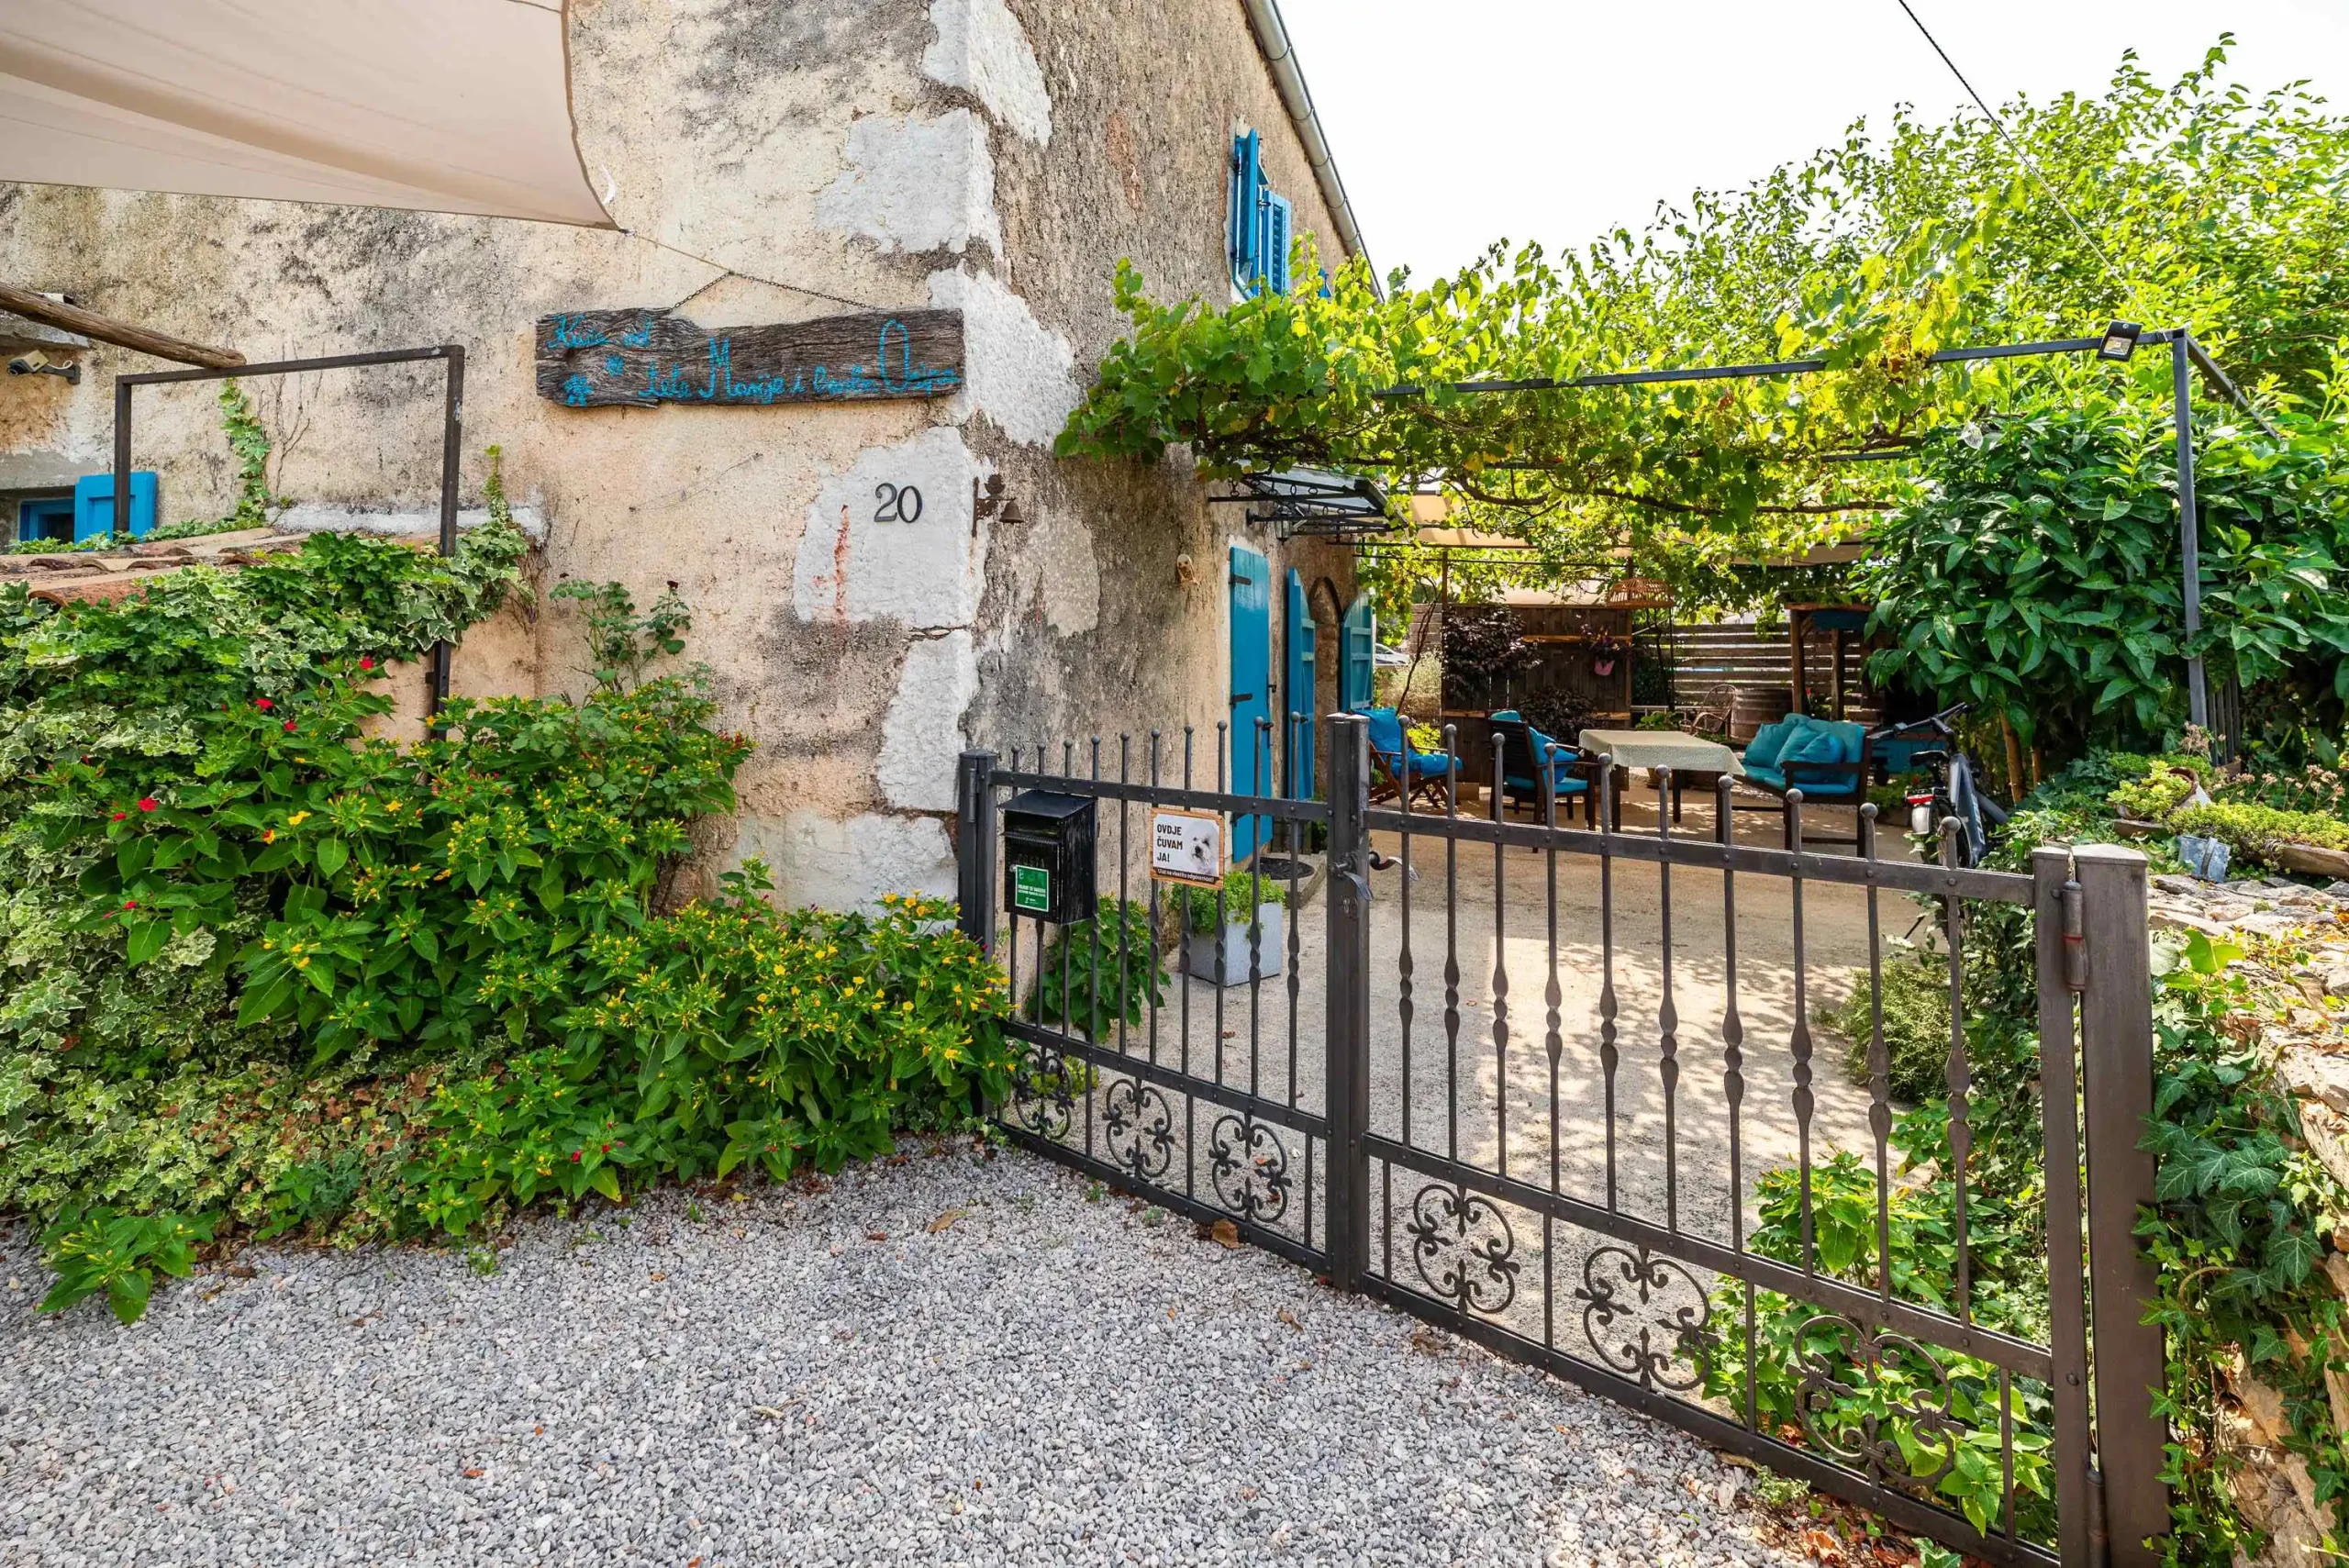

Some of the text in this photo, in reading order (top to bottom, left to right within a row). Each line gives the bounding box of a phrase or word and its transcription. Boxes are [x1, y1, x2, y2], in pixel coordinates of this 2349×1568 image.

[874, 483, 922, 524] 20
[1157, 824, 1182, 836] OVDJE
[1157, 836, 1183, 850] ČUVAM
[1157, 852, 1170, 862] JA!
